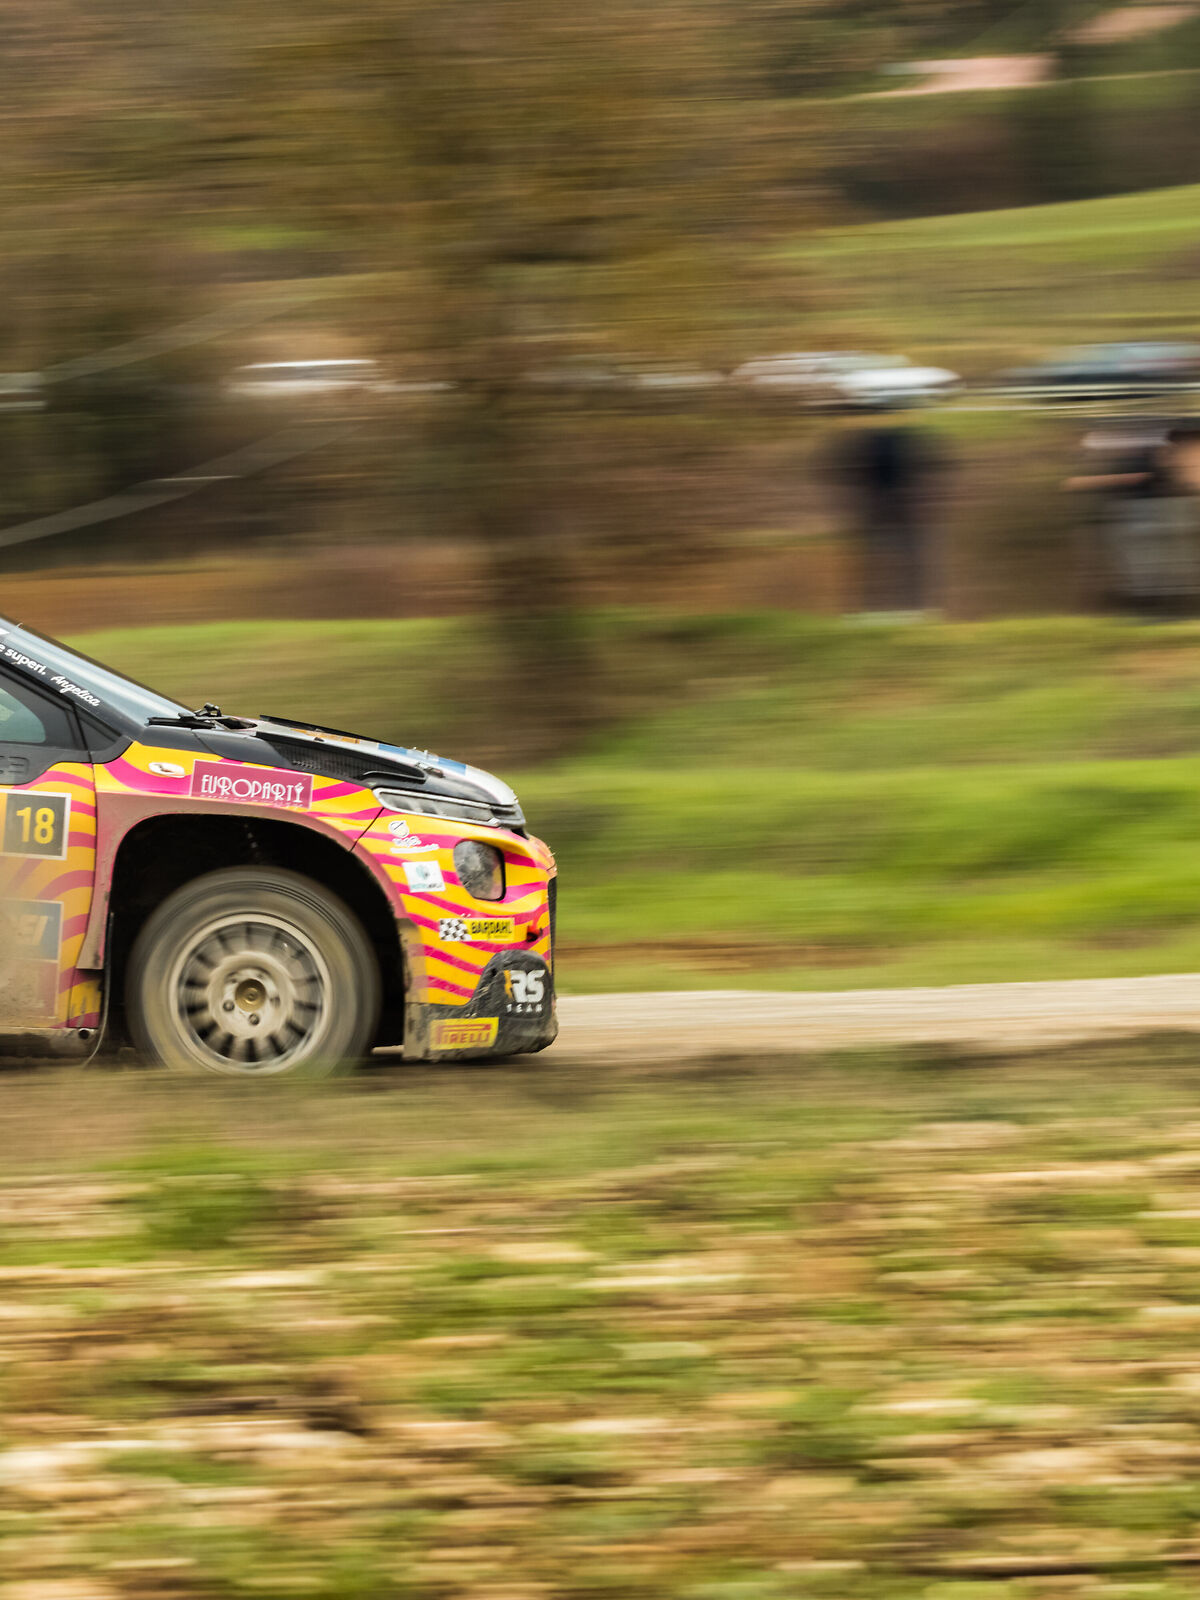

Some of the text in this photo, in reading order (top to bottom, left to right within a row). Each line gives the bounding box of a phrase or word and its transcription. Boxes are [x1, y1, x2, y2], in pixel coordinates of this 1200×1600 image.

[50, 674, 101, 707] Angelica
[200, 774, 305, 803] EUROPARTY
[16, 807, 55, 845] 18
[471, 921, 513, 936] BARDAHL
[510, 969, 546, 1003] RS
[506, 1003, 543, 1014] TEAM
[437, 1023, 492, 1045] PIRELLI
